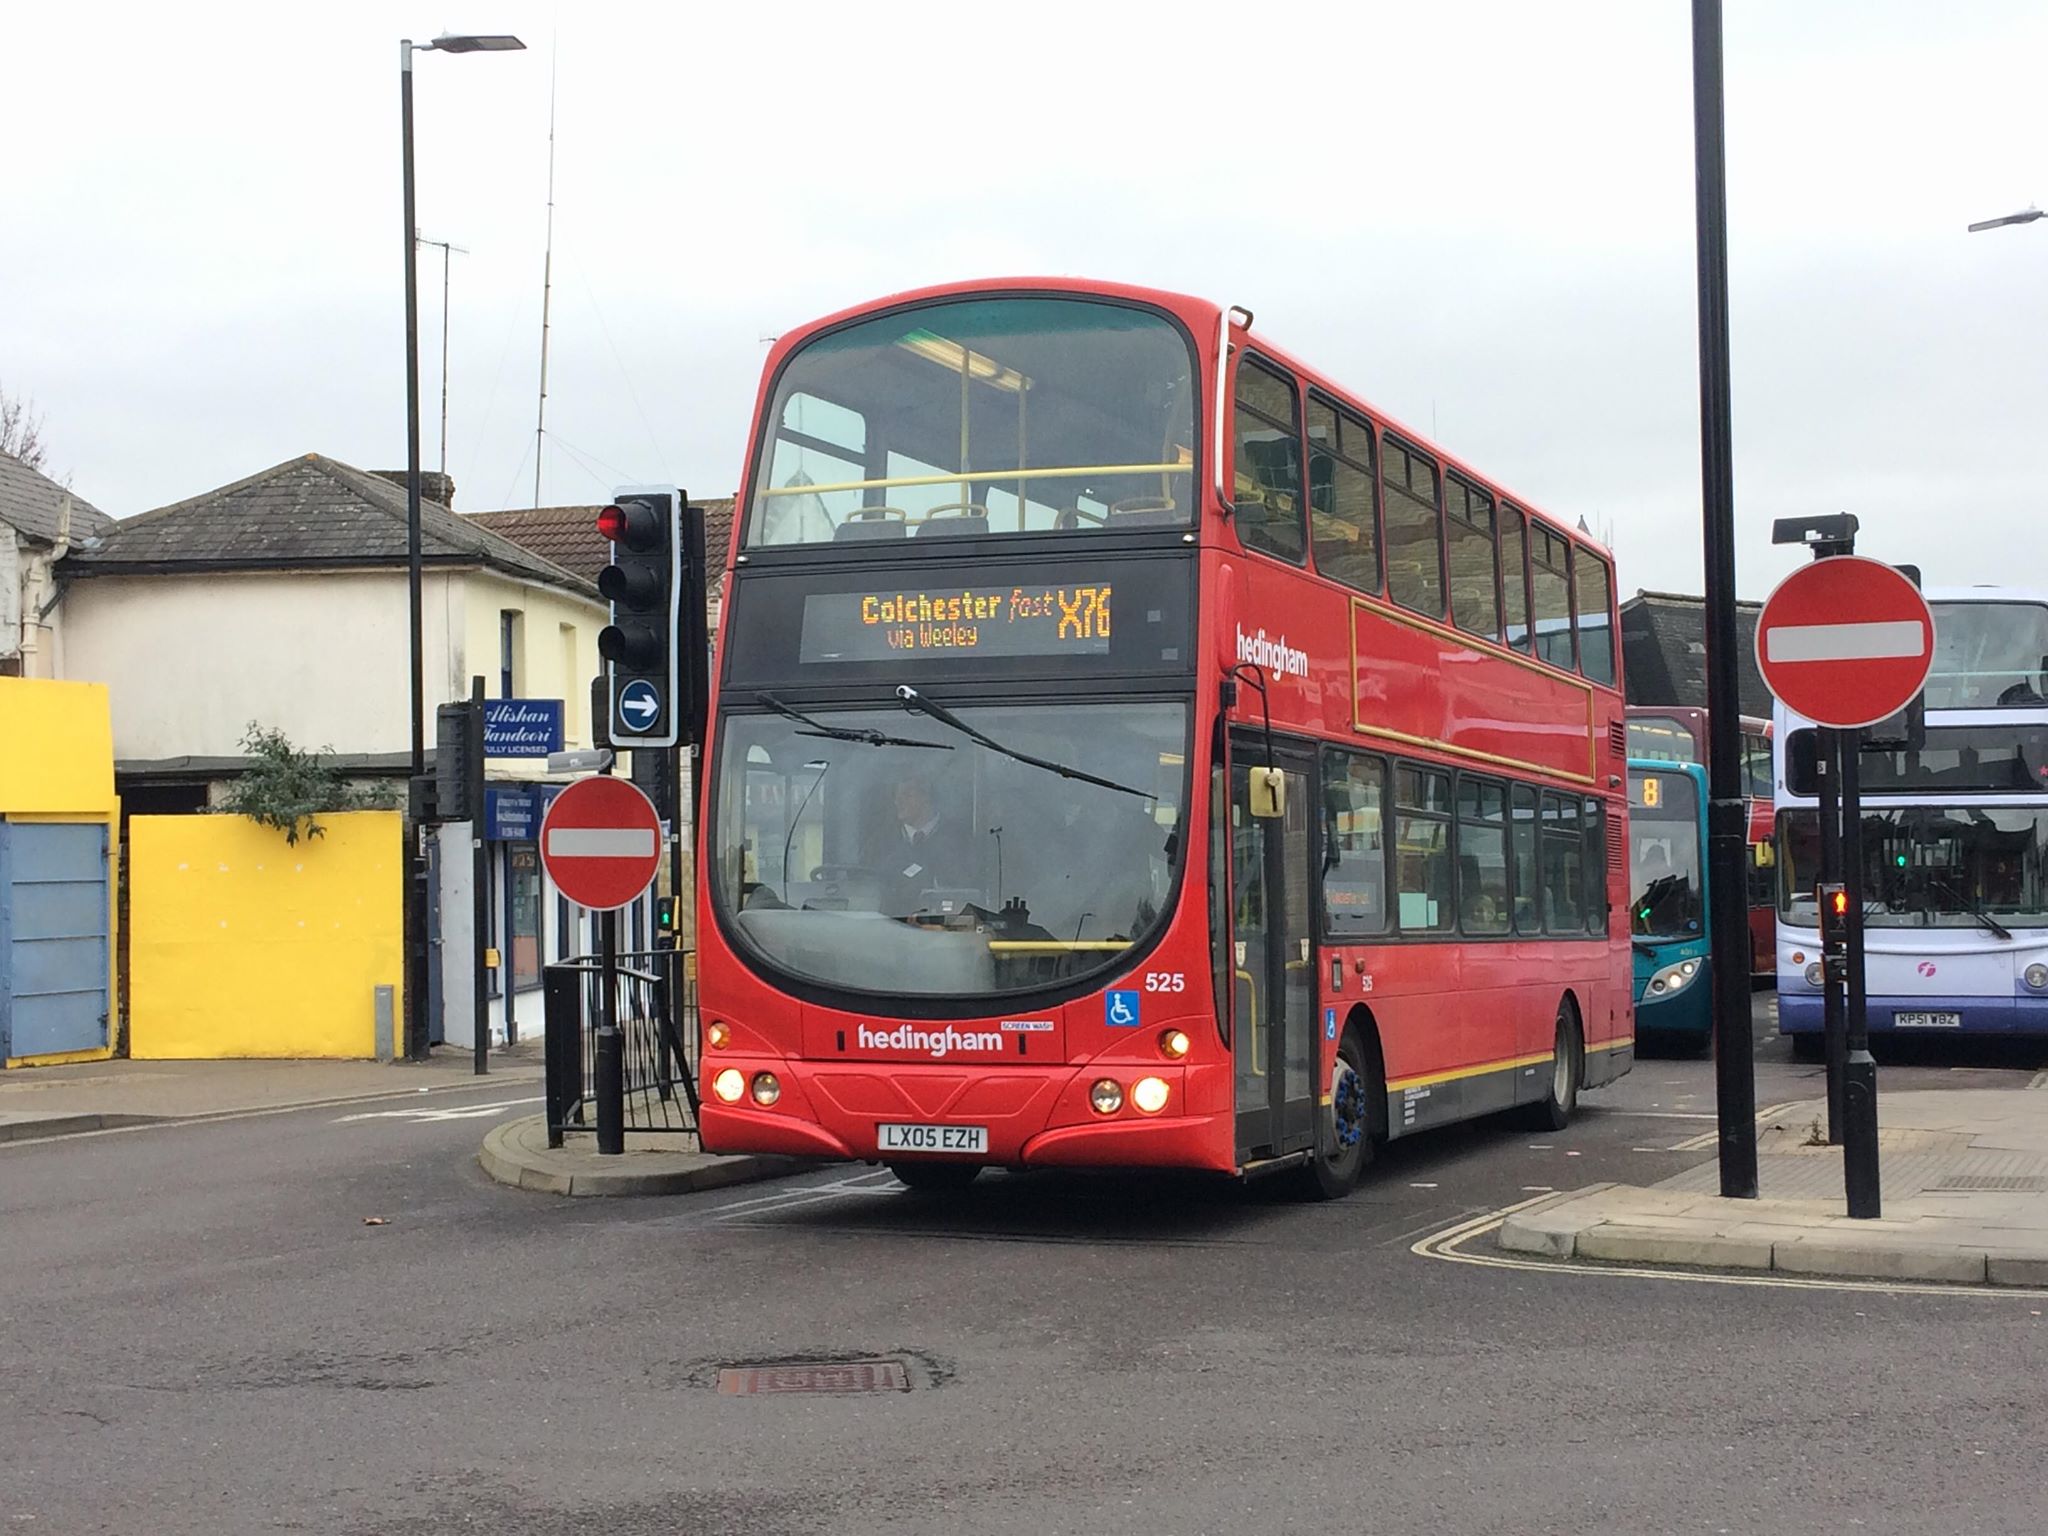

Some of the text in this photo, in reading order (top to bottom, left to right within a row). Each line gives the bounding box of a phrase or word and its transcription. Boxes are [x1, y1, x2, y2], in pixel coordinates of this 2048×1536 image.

[862, 587, 1054, 624] Colchester fast
[1058, 586, 1111, 639] X76
[887, 623, 977, 650] via Weeley
[1237, 621, 1308, 682] hedingham
[1643, 778, 1658, 807] 8
[1145, 973, 1185, 992] 525
[858, 1024, 1003, 1056] hedingham
[887, 1127, 980, 1149] LX05 EZH
